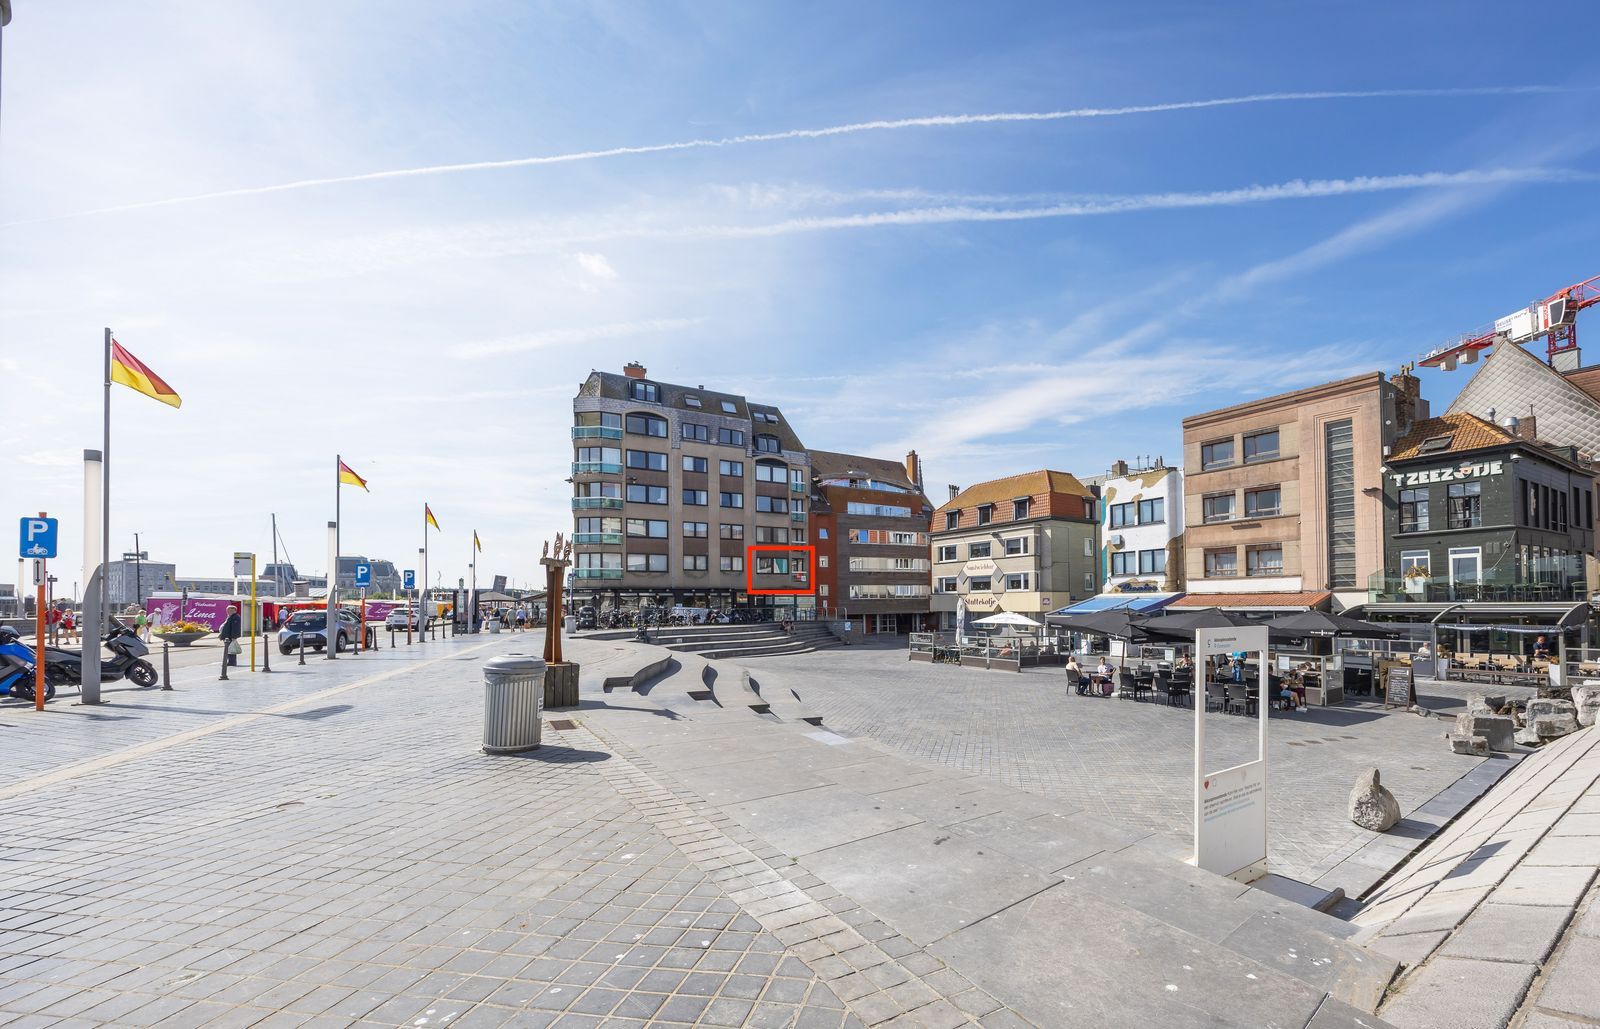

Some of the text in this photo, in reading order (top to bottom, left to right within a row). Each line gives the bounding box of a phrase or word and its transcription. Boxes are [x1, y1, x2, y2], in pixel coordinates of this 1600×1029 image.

[28, 520, 49, 542] P
[357, 566, 368, 579] P
[405, 572, 413, 583] P
[185, 608, 216, 618] Lima
